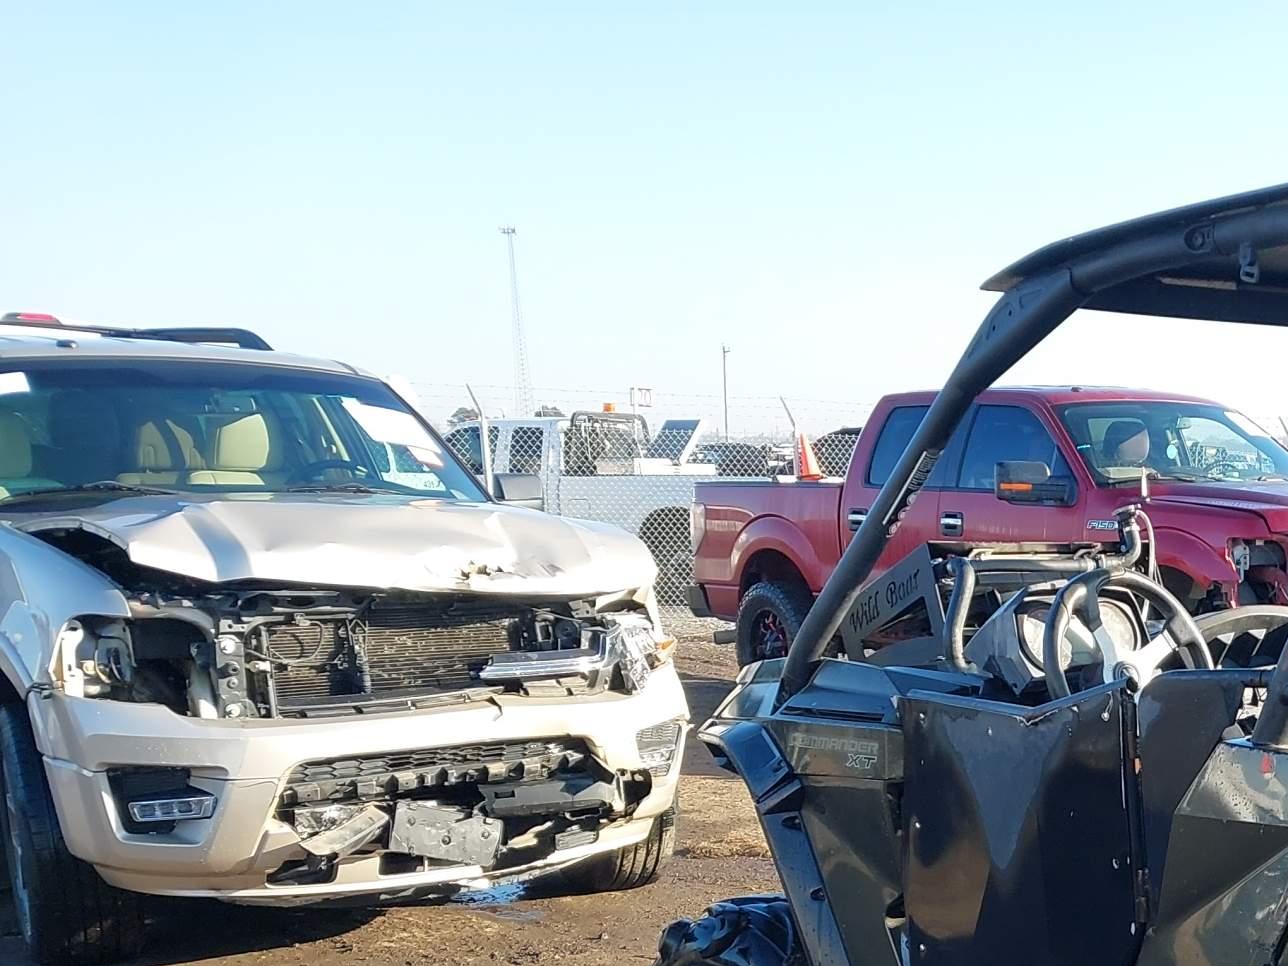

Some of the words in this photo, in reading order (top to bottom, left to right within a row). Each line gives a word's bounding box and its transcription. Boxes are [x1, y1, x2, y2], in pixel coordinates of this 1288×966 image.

[849, 590, 880, 633] Wild
[885, 568, 920, 609] Boar
[846, 752, 878, 769] XT
